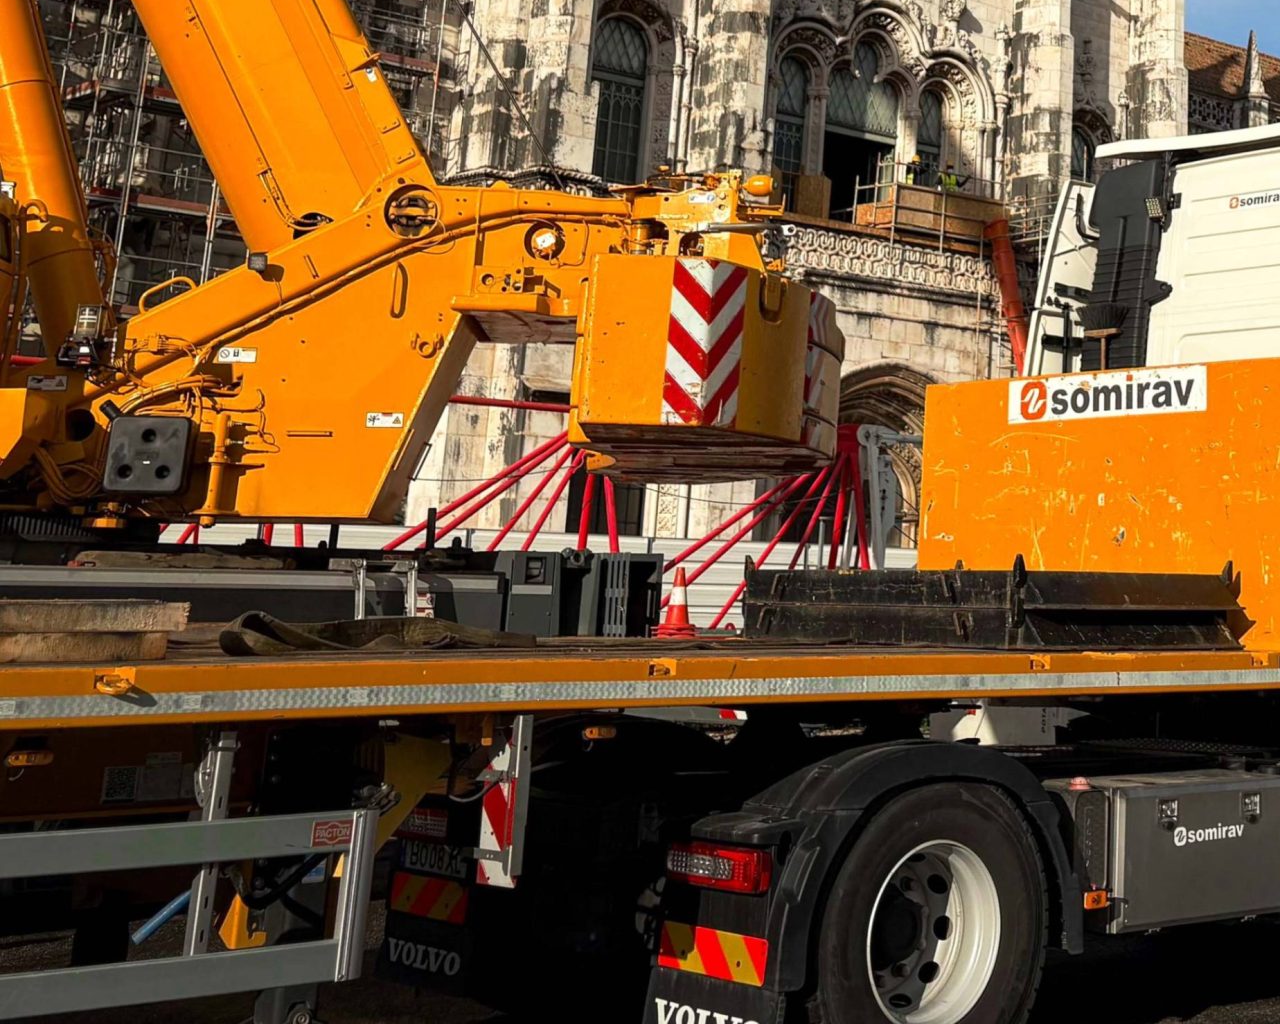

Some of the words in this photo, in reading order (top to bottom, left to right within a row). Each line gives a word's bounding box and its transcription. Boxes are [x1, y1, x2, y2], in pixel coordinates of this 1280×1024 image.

[1051, 373, 1195, 415] somirav
[1188, 823, 1244, 843] somirav
[388, 936, 461, 976] VOLVO
